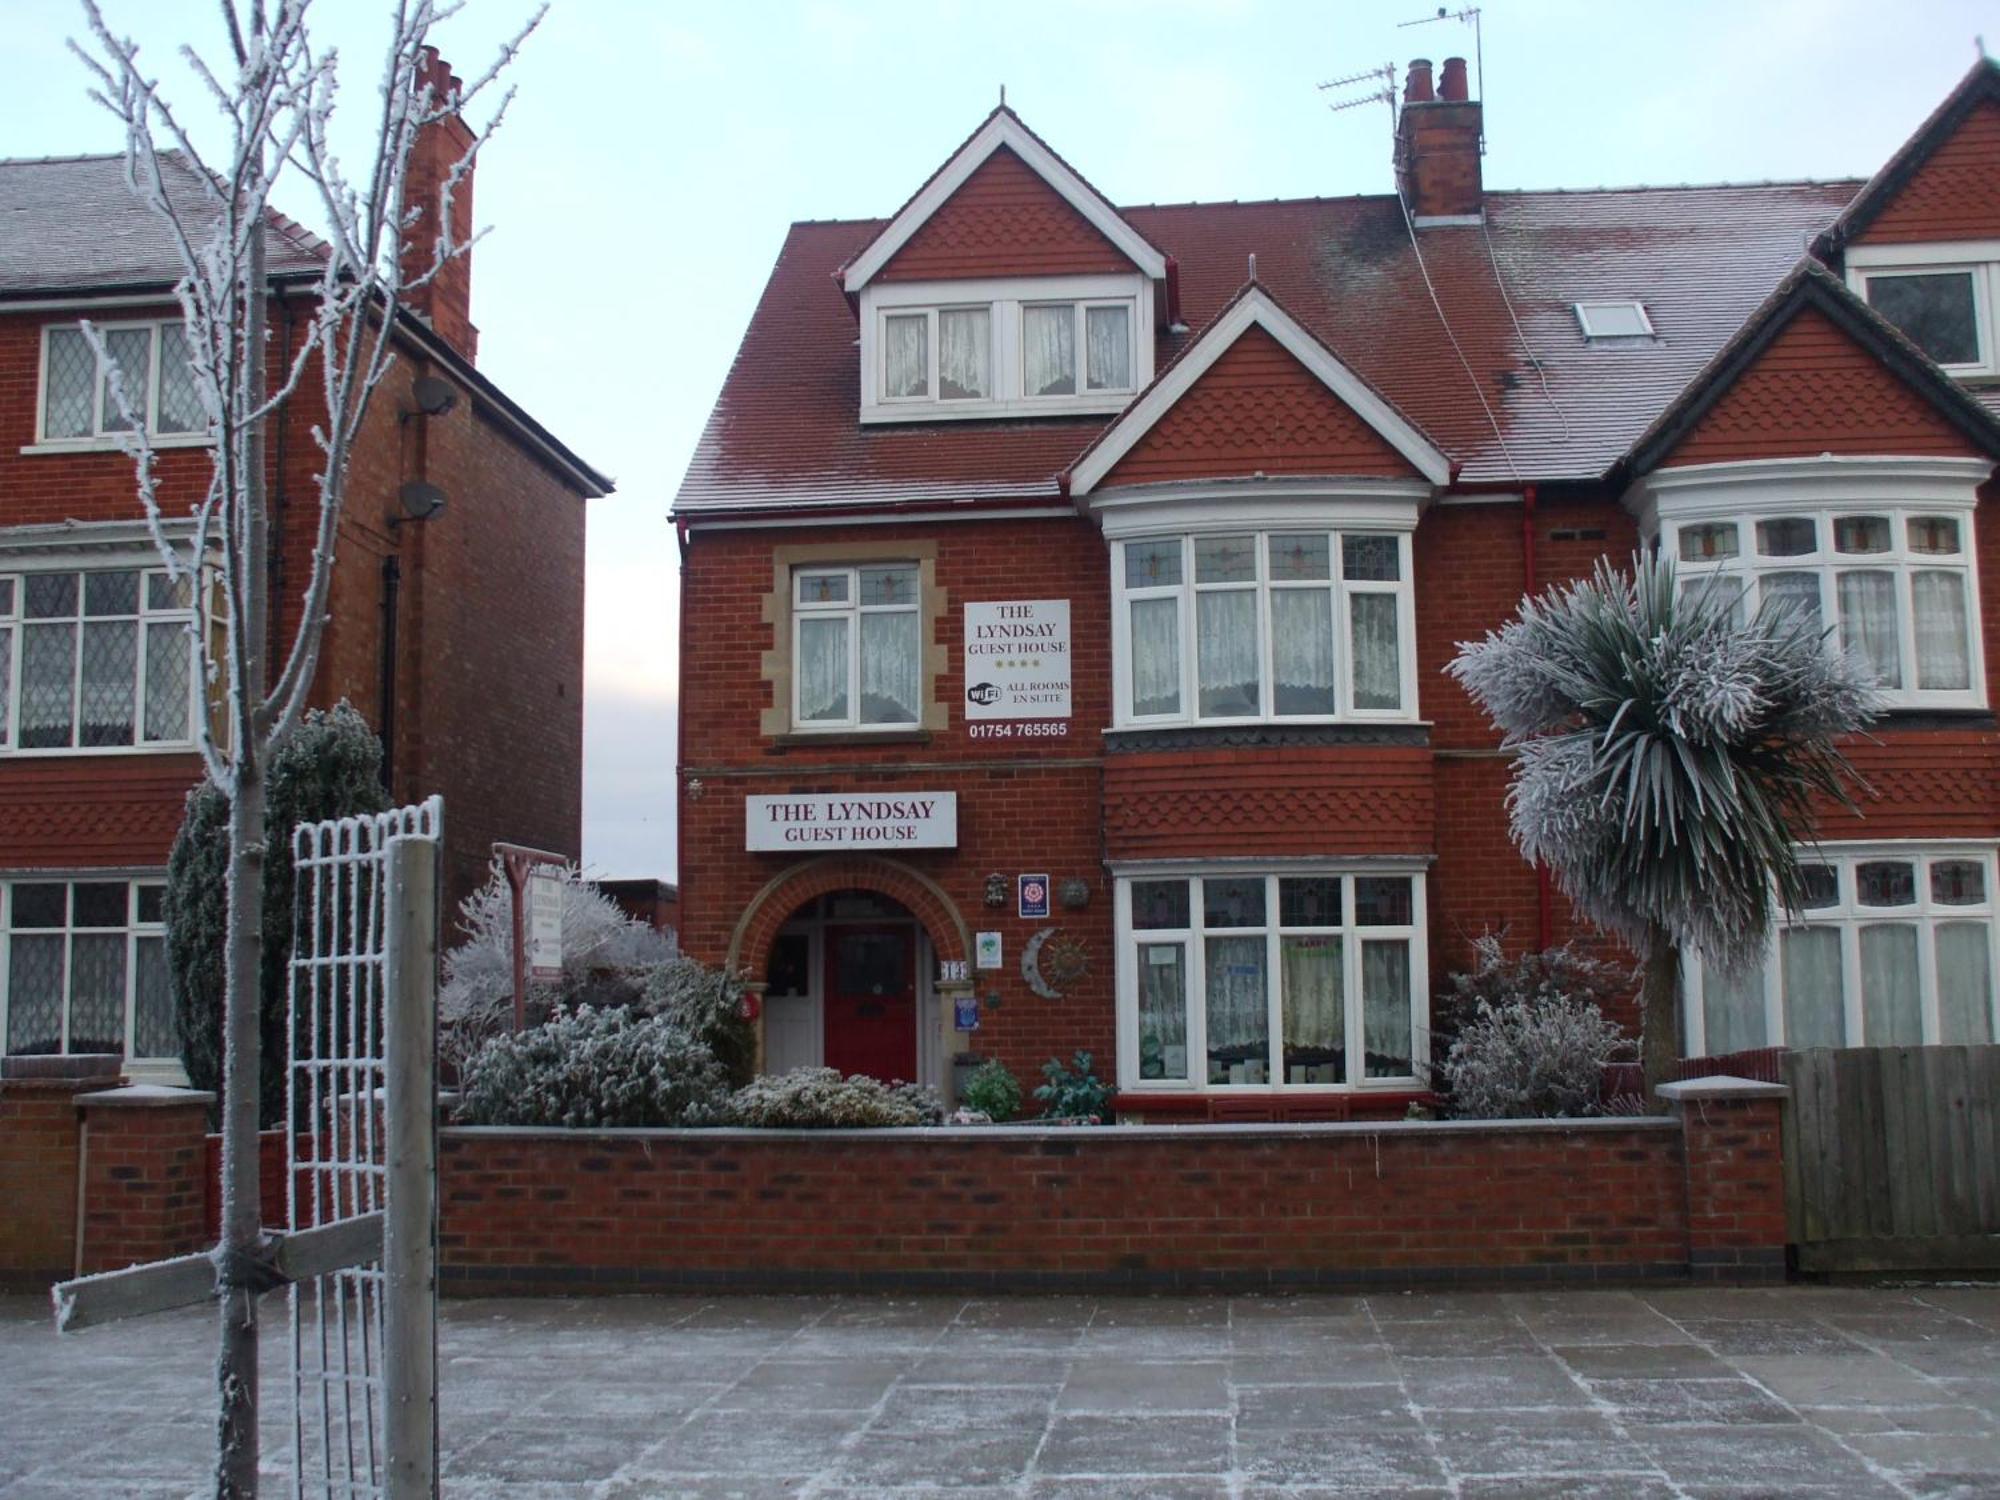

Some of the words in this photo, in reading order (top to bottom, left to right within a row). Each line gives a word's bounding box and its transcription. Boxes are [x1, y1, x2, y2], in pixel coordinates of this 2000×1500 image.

[997, 605, 1034, 618] THE
[977, 623, 1057, 639] LYNDSAY
[968, 643, 1014, 655] GUEST
[1018, 641, 1067, 653] HOUSE
[1007, 682, 1028, 692] ALL
[1030, 681, 1070, 691] ROOMS
[1013, 694, 1029, 704] EN
[1031, 693, 1063, 703] SUITE
[969, 724, 1012, 738] 01754
[1016, 722, 1067, 737] 765565
[766, 803, 817, 822] THE
[827, 801, 935, 821] LYNDSAY
[785, 826, 848, 842] GUEST
[852, 825, 918, 841] HOUSE
